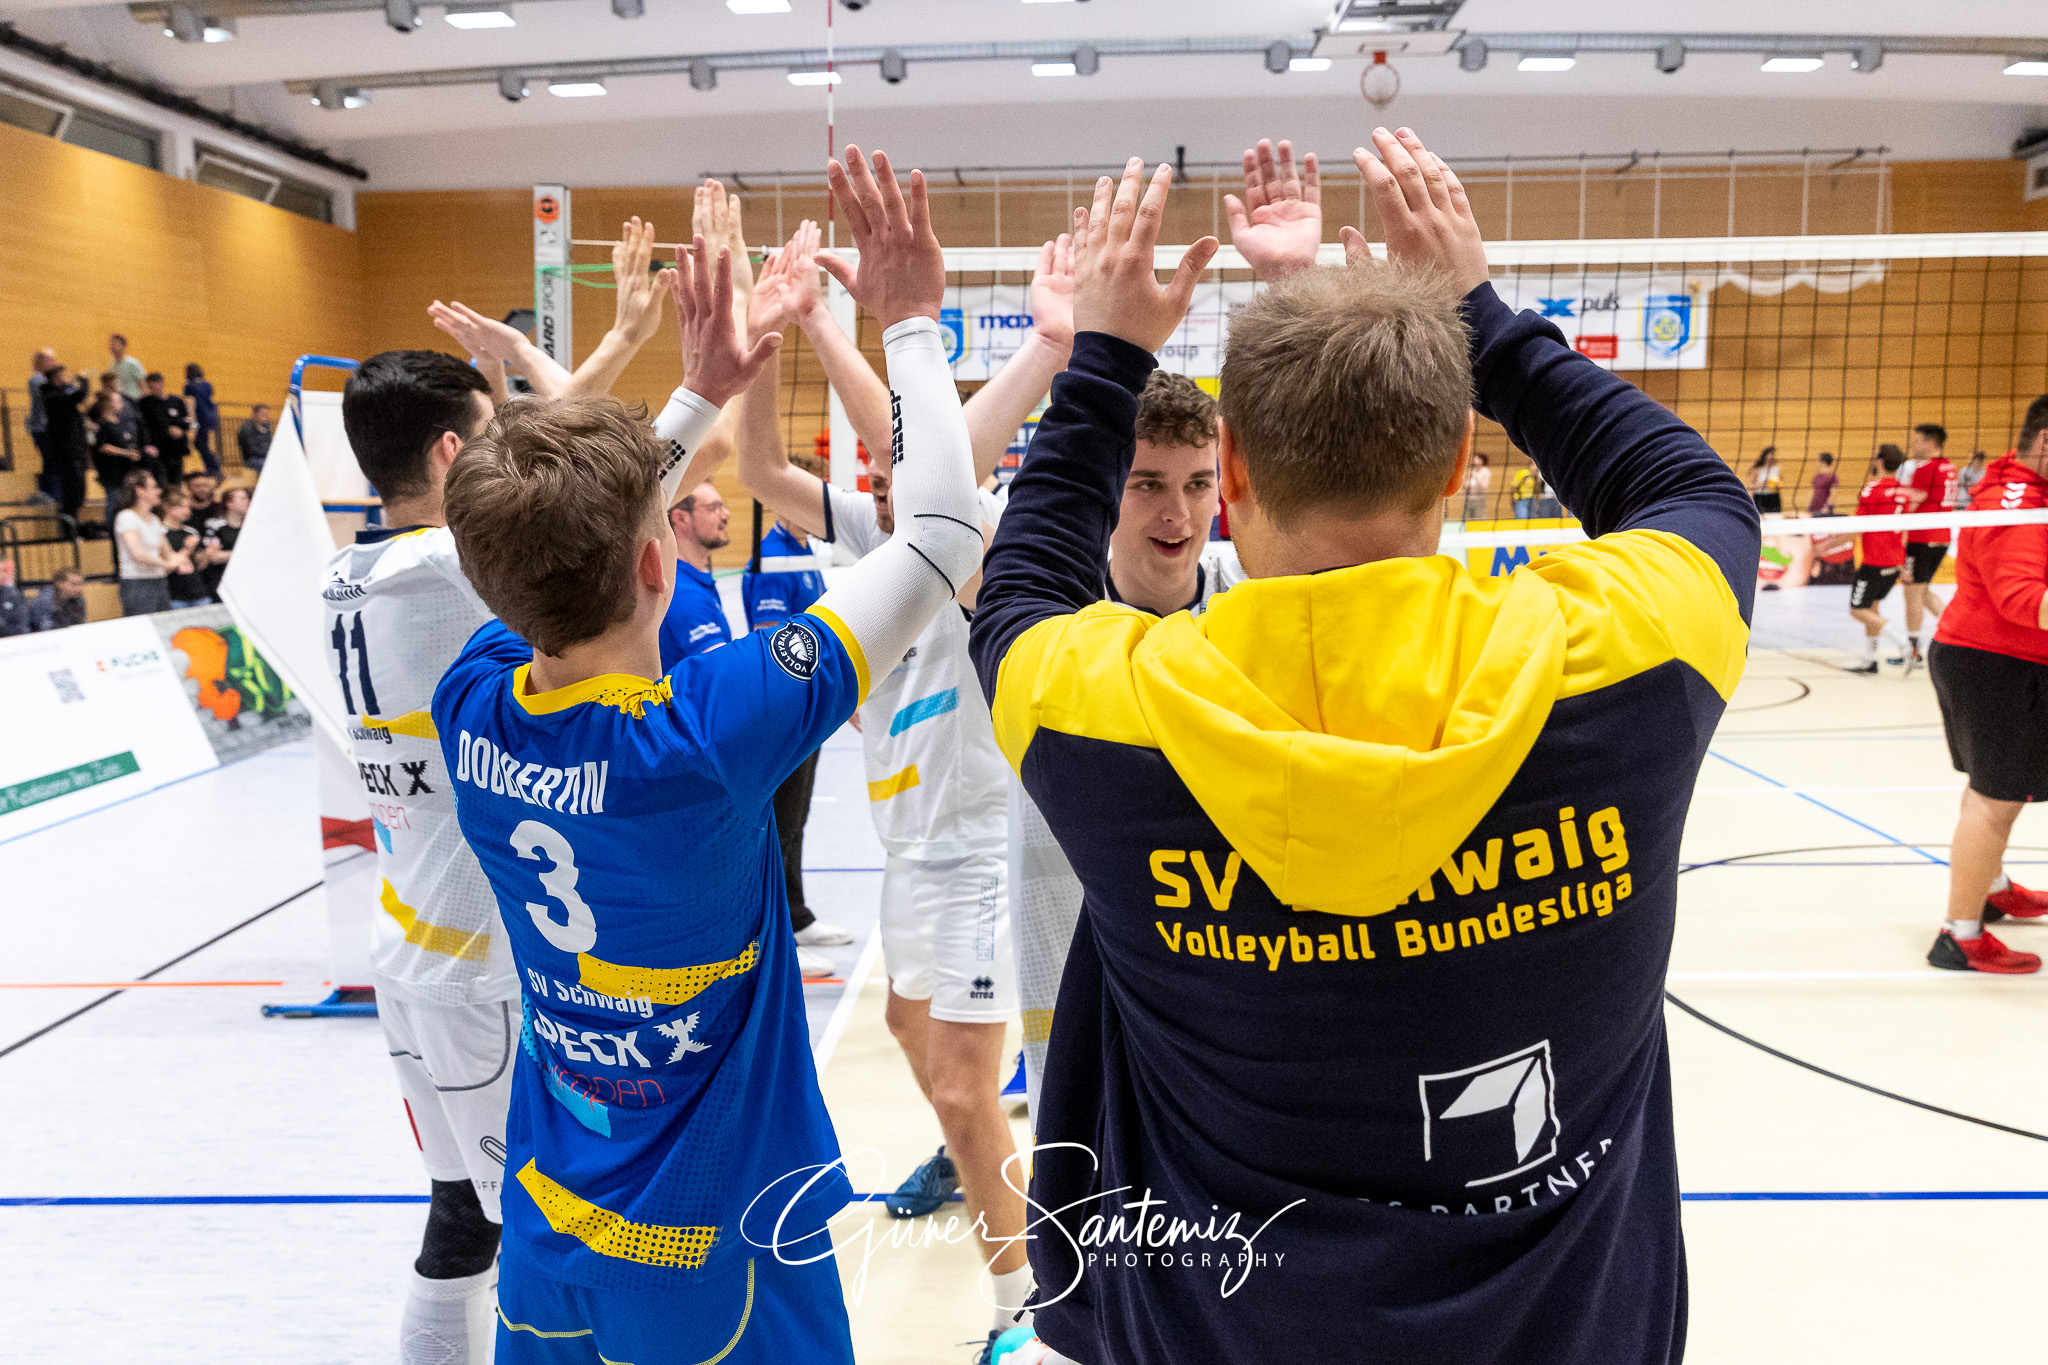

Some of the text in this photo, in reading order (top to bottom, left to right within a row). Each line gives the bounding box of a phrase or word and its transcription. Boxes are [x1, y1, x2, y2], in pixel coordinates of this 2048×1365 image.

[1157, 345, 1199, 362] roup
[331, 610, 381, 715] 11
[777, 630, 807, 673] VOLLEYBALL
[456, 729, 609, 815] DOBBERTIN
[509, 819, 598, 954] 3
[1149, 806, 1630, 912] SV waig
[1155, 872, 1633, 972] Volleyball Bundesliga
[527, 967, 654, 1019] SV Schwaig
[533, 1008, 652, 1068] PECK
